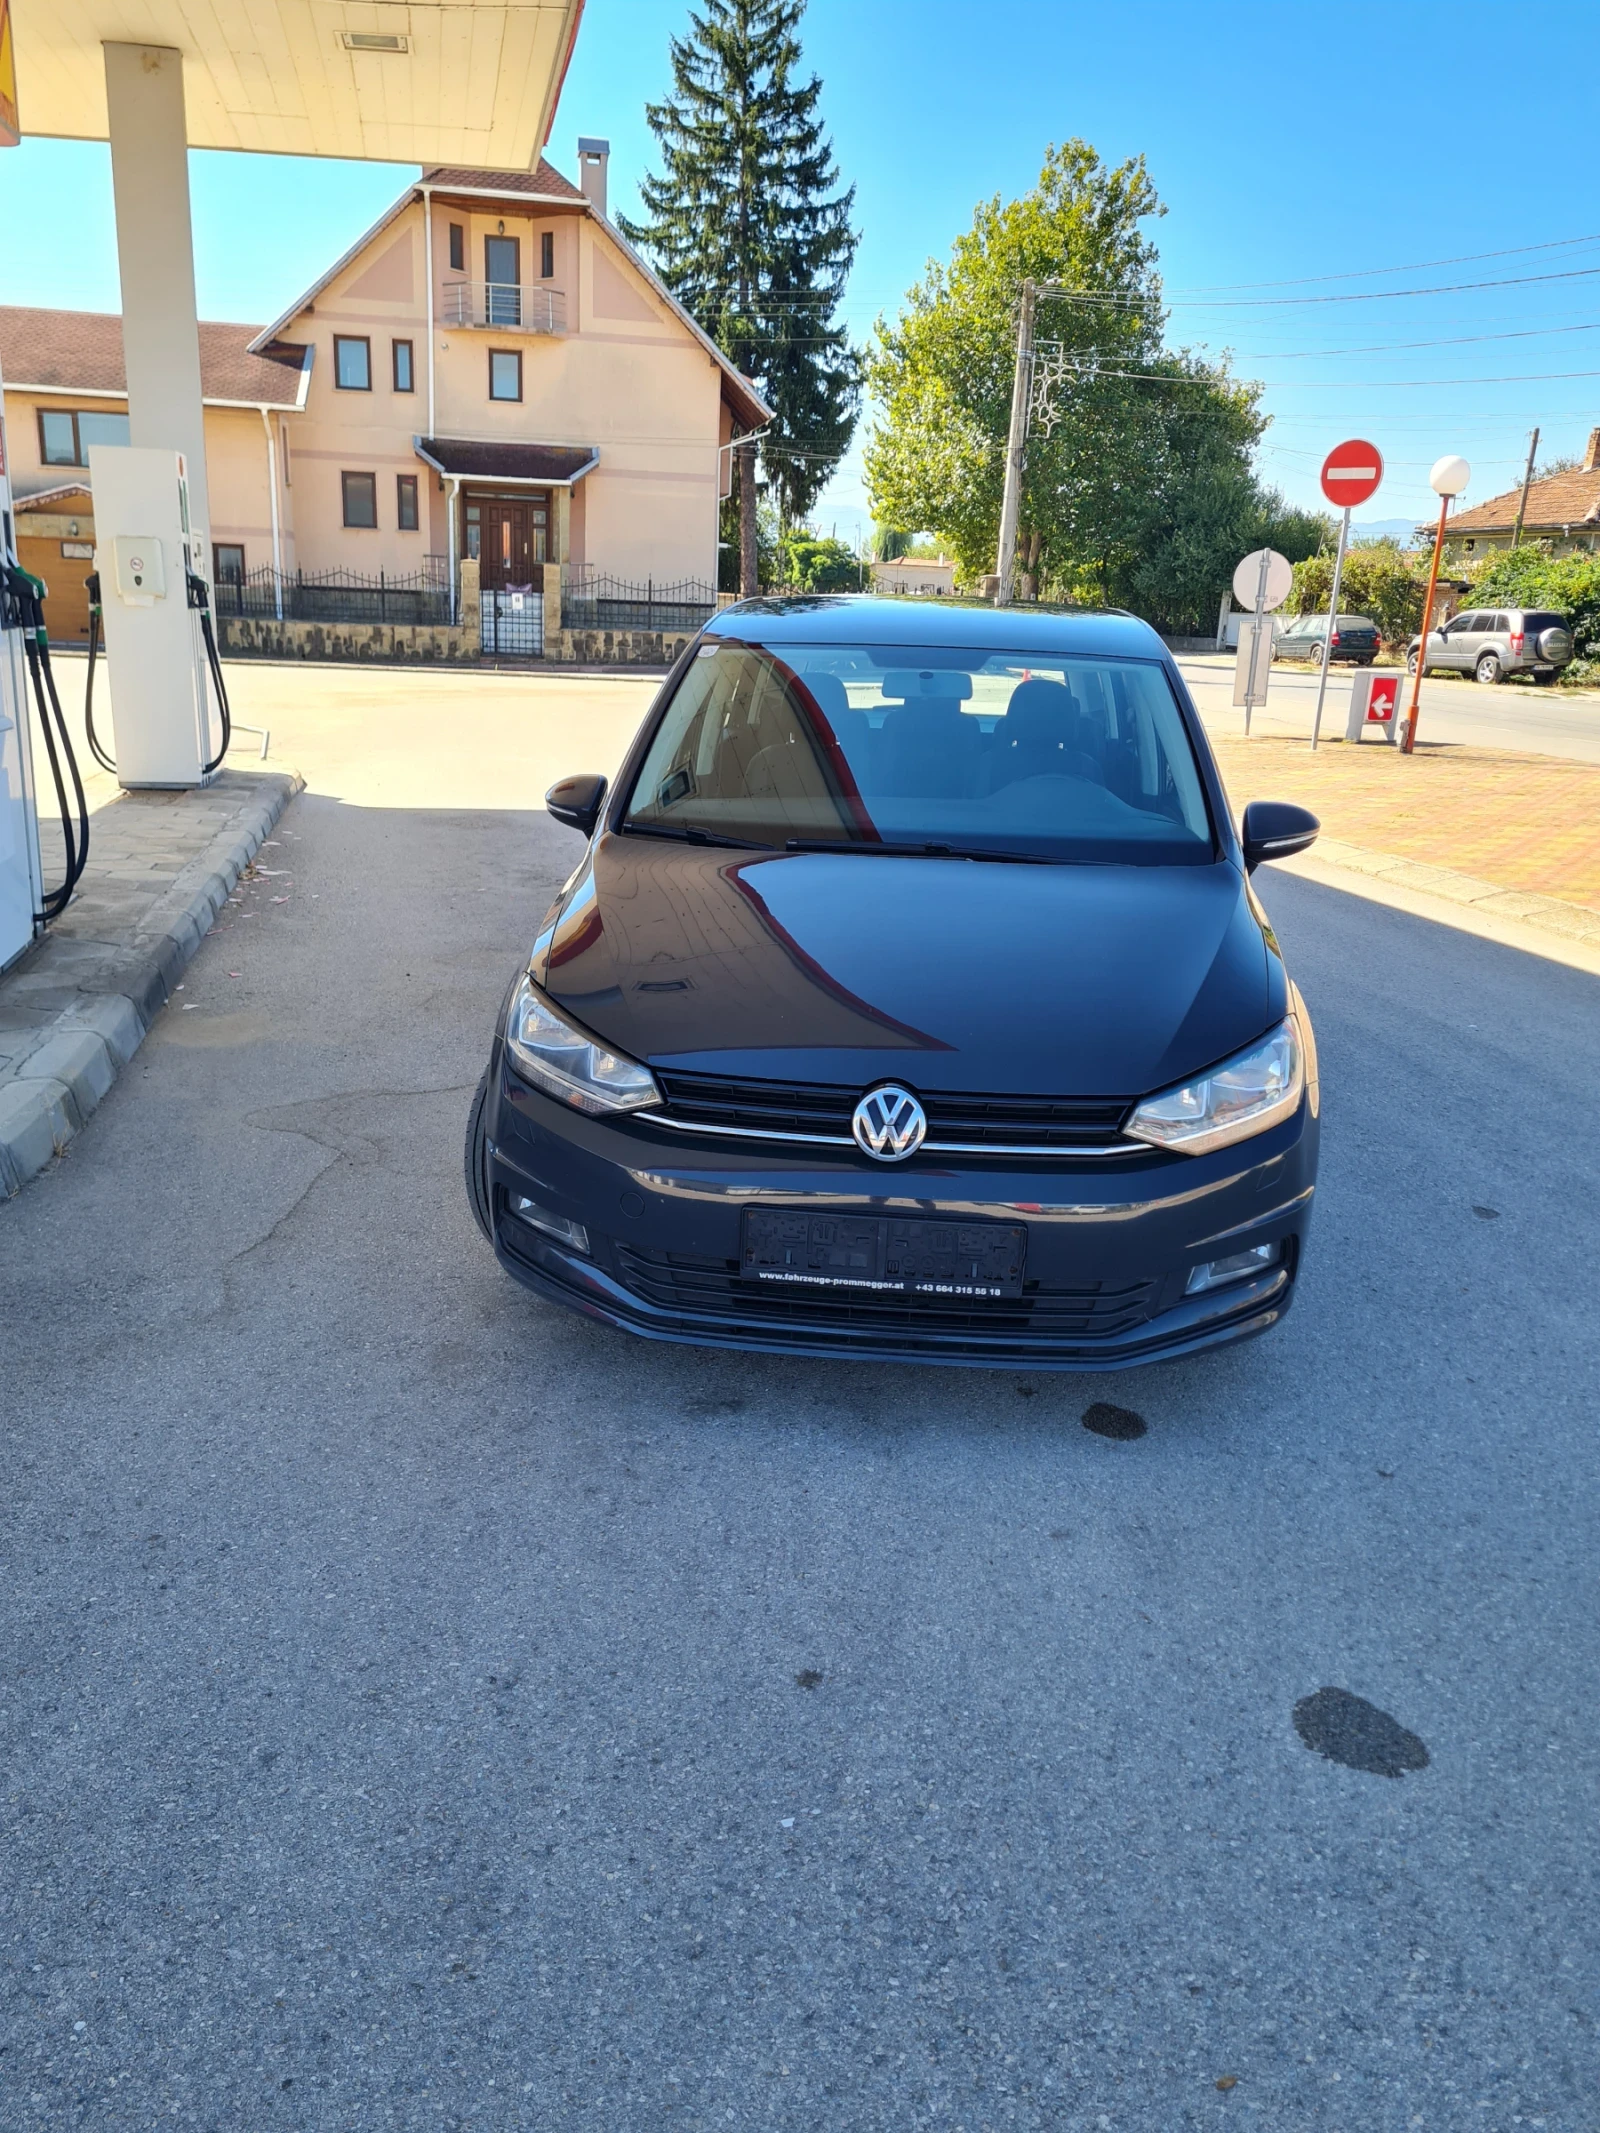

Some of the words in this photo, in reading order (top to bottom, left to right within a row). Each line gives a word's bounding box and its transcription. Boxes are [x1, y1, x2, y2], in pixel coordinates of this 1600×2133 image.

[852, 1086, 927, 1162] VW
[759, 1271, 905, 1290] www.fahrzeuge-prommegger.at
[915, 1284, 934, 1292] +43
[936, 1285, 953, 1293] 664
[955, 1286, 973, 1294] 315
[989, 1288, 1001, 1296] 18
